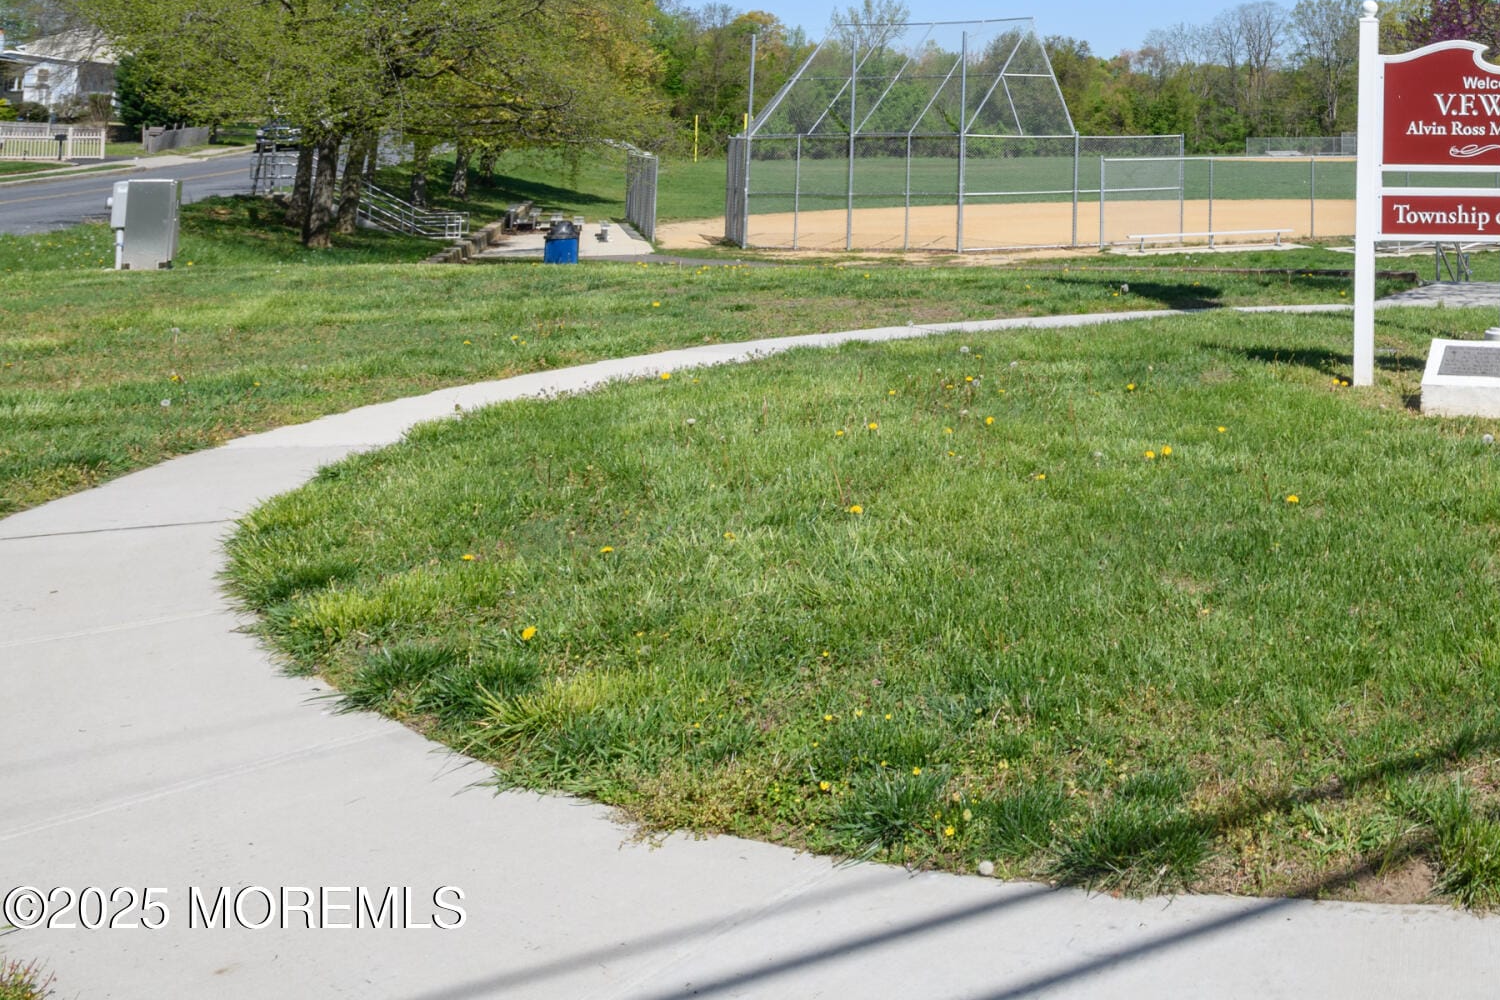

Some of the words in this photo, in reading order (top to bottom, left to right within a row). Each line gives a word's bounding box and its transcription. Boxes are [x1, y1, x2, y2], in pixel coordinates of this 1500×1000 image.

[1405, 120, 1447, 136] Alvin
[1451, 121, 1486, 136] Ross
[1393, 204, 1490, 231] Township
